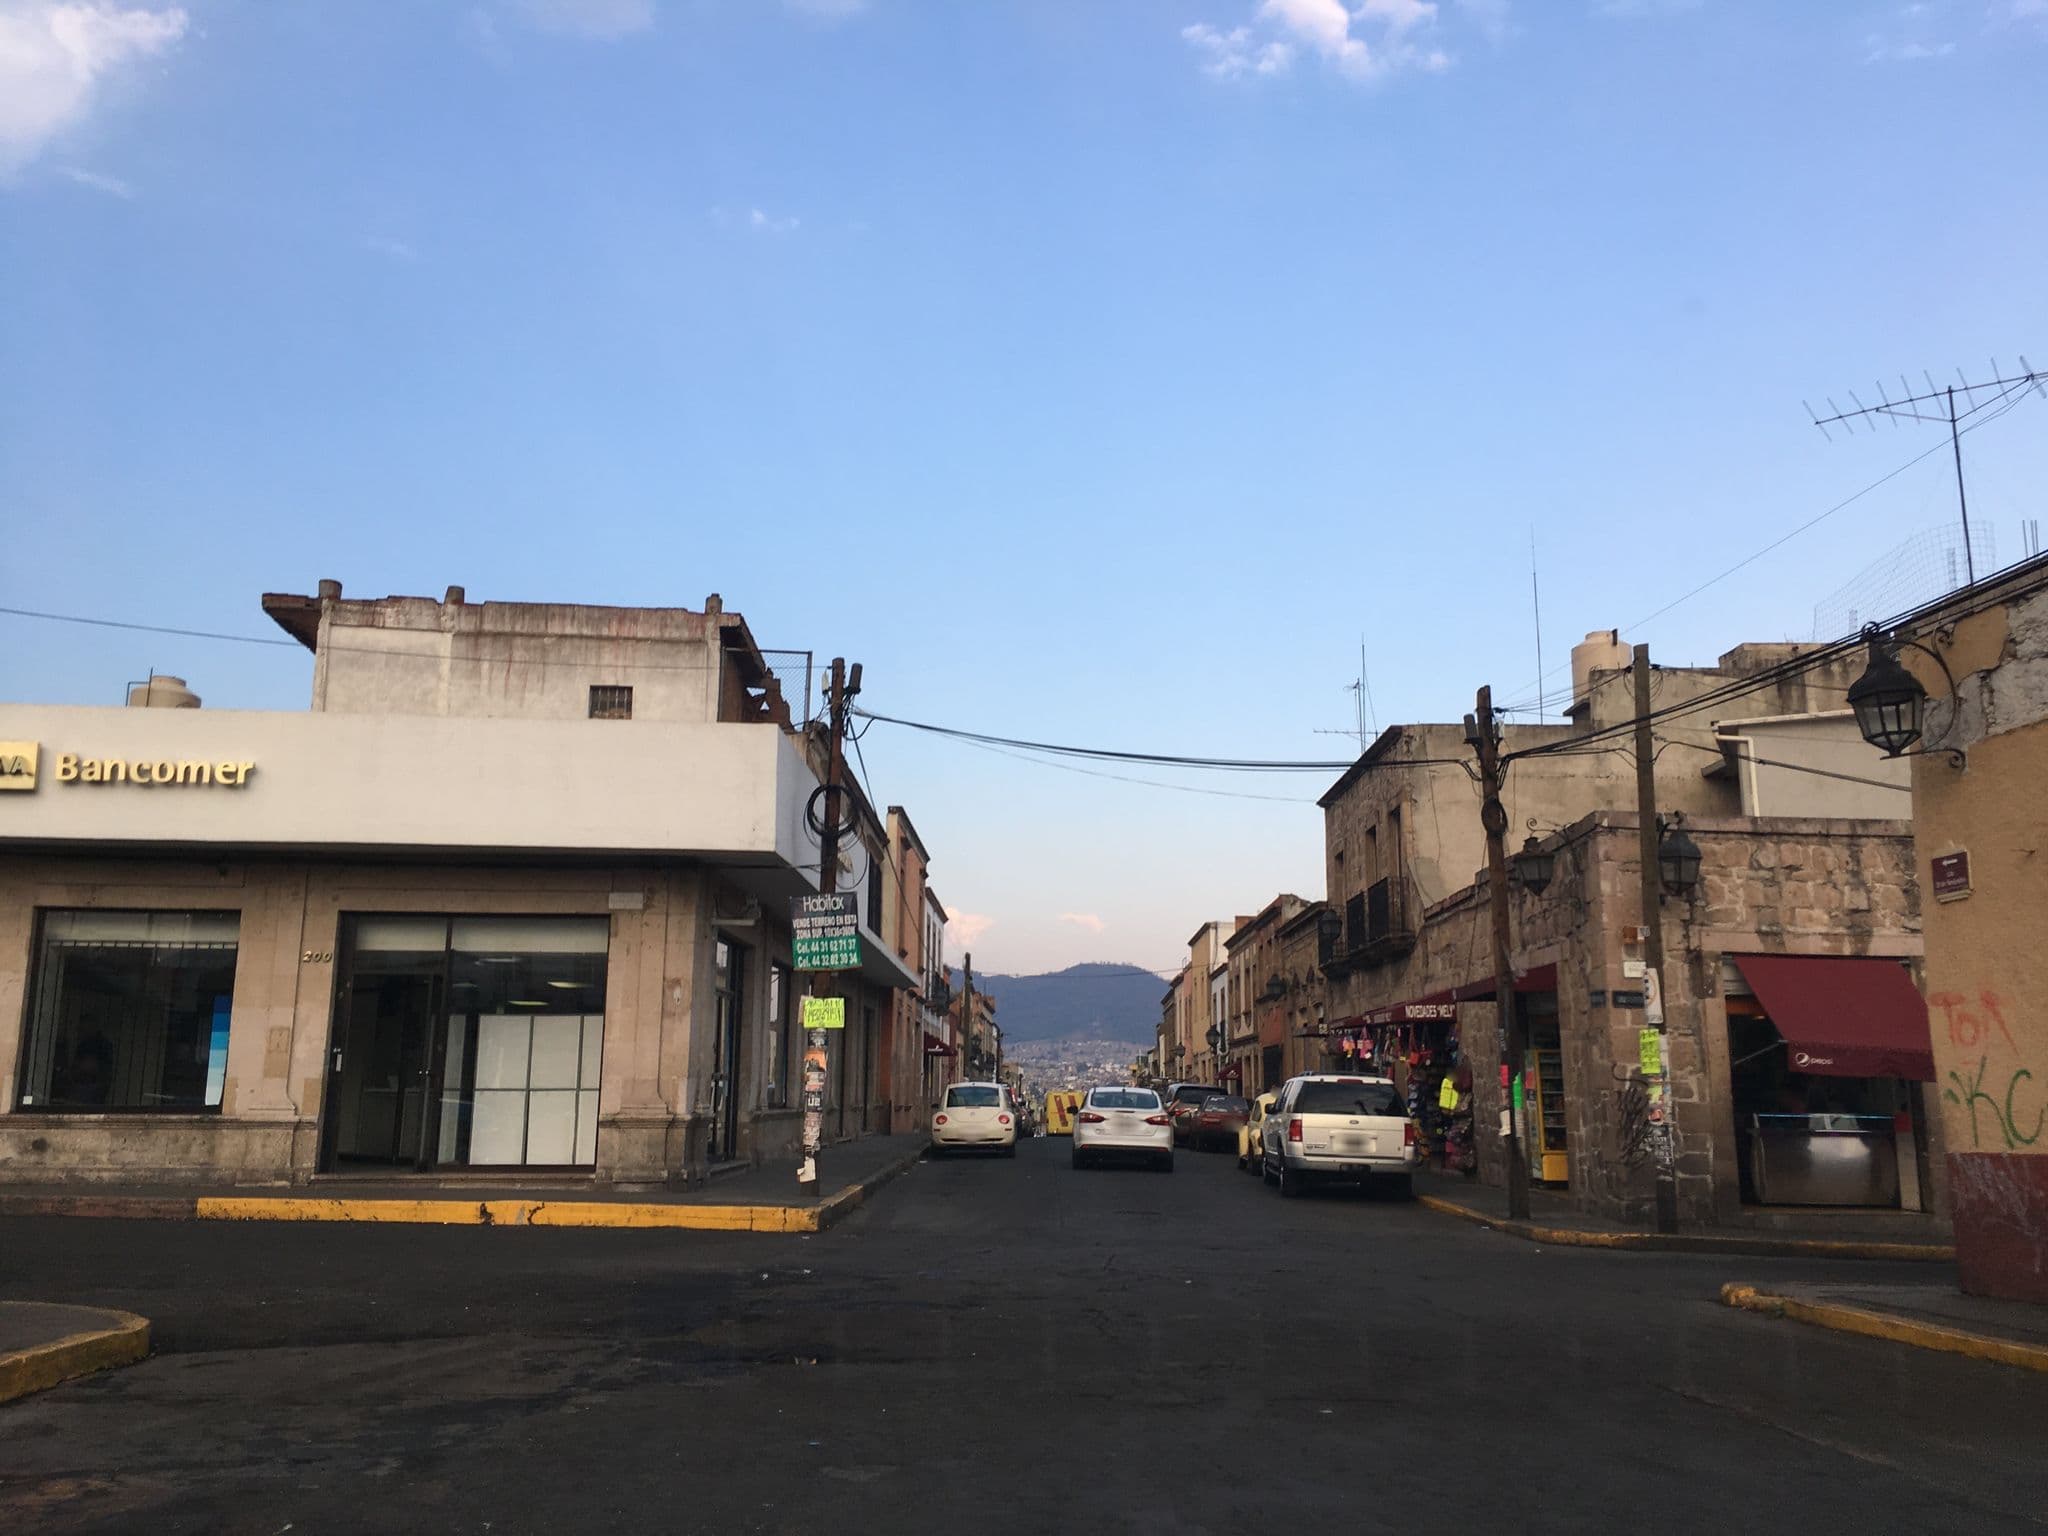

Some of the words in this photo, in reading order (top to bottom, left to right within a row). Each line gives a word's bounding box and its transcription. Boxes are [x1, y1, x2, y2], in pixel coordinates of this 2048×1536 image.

[55, 752, 255, 785] Bancomer
[802, 894, 845, 912] Habitax
[792, 917, 811, 929] VENDE
[811, 915, 836, 928] TERRENO
[836, 914, 844, 926] EN
[844, 914, 857, 925] ESTA
[303, 950, 333, 963] 200
[1405, 1004, 1437, 1018] NOVEDADES
[1811, 1057, 1834, 1065] pepsi
